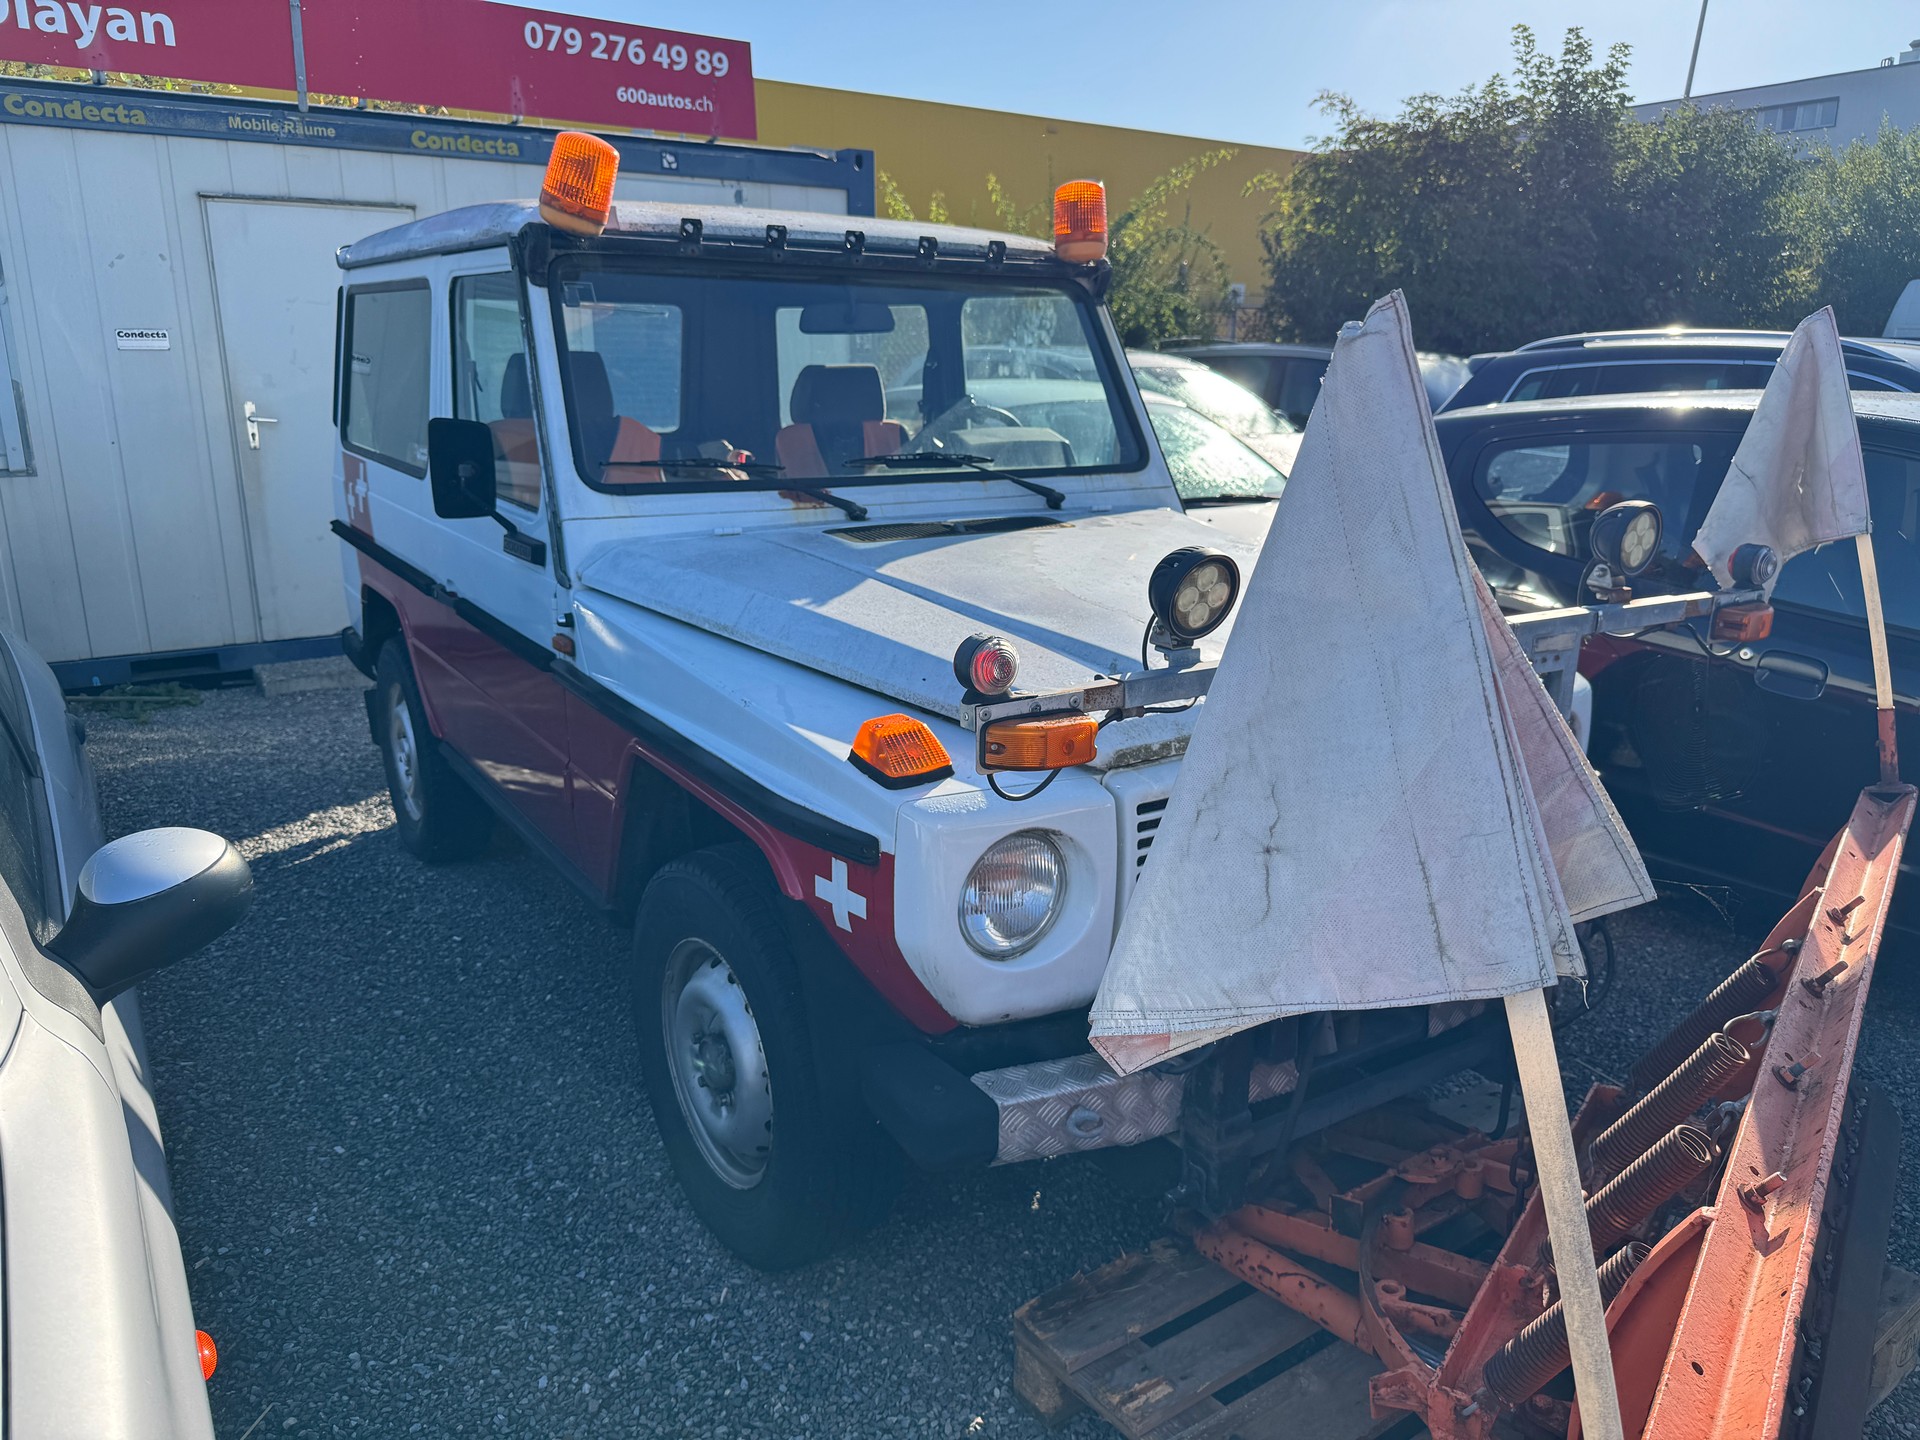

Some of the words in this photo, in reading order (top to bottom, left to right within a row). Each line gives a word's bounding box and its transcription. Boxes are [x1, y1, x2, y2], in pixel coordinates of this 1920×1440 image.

[0, 0, 176, 49] layan
[524, 21, 583, 55] 079
[590, 31, 646, 66] 276
[652, 42, 688, 72] 49
[694, 49, 729, 78] 89
[3, 93, 147, 125] Condecta
[616, 86, 714, 112] 600autos.ch
[228, 116, 279, 133] Mobile
[411, 130, 519, 156] Condecta
[116, 330, 167, 338] Condecta
